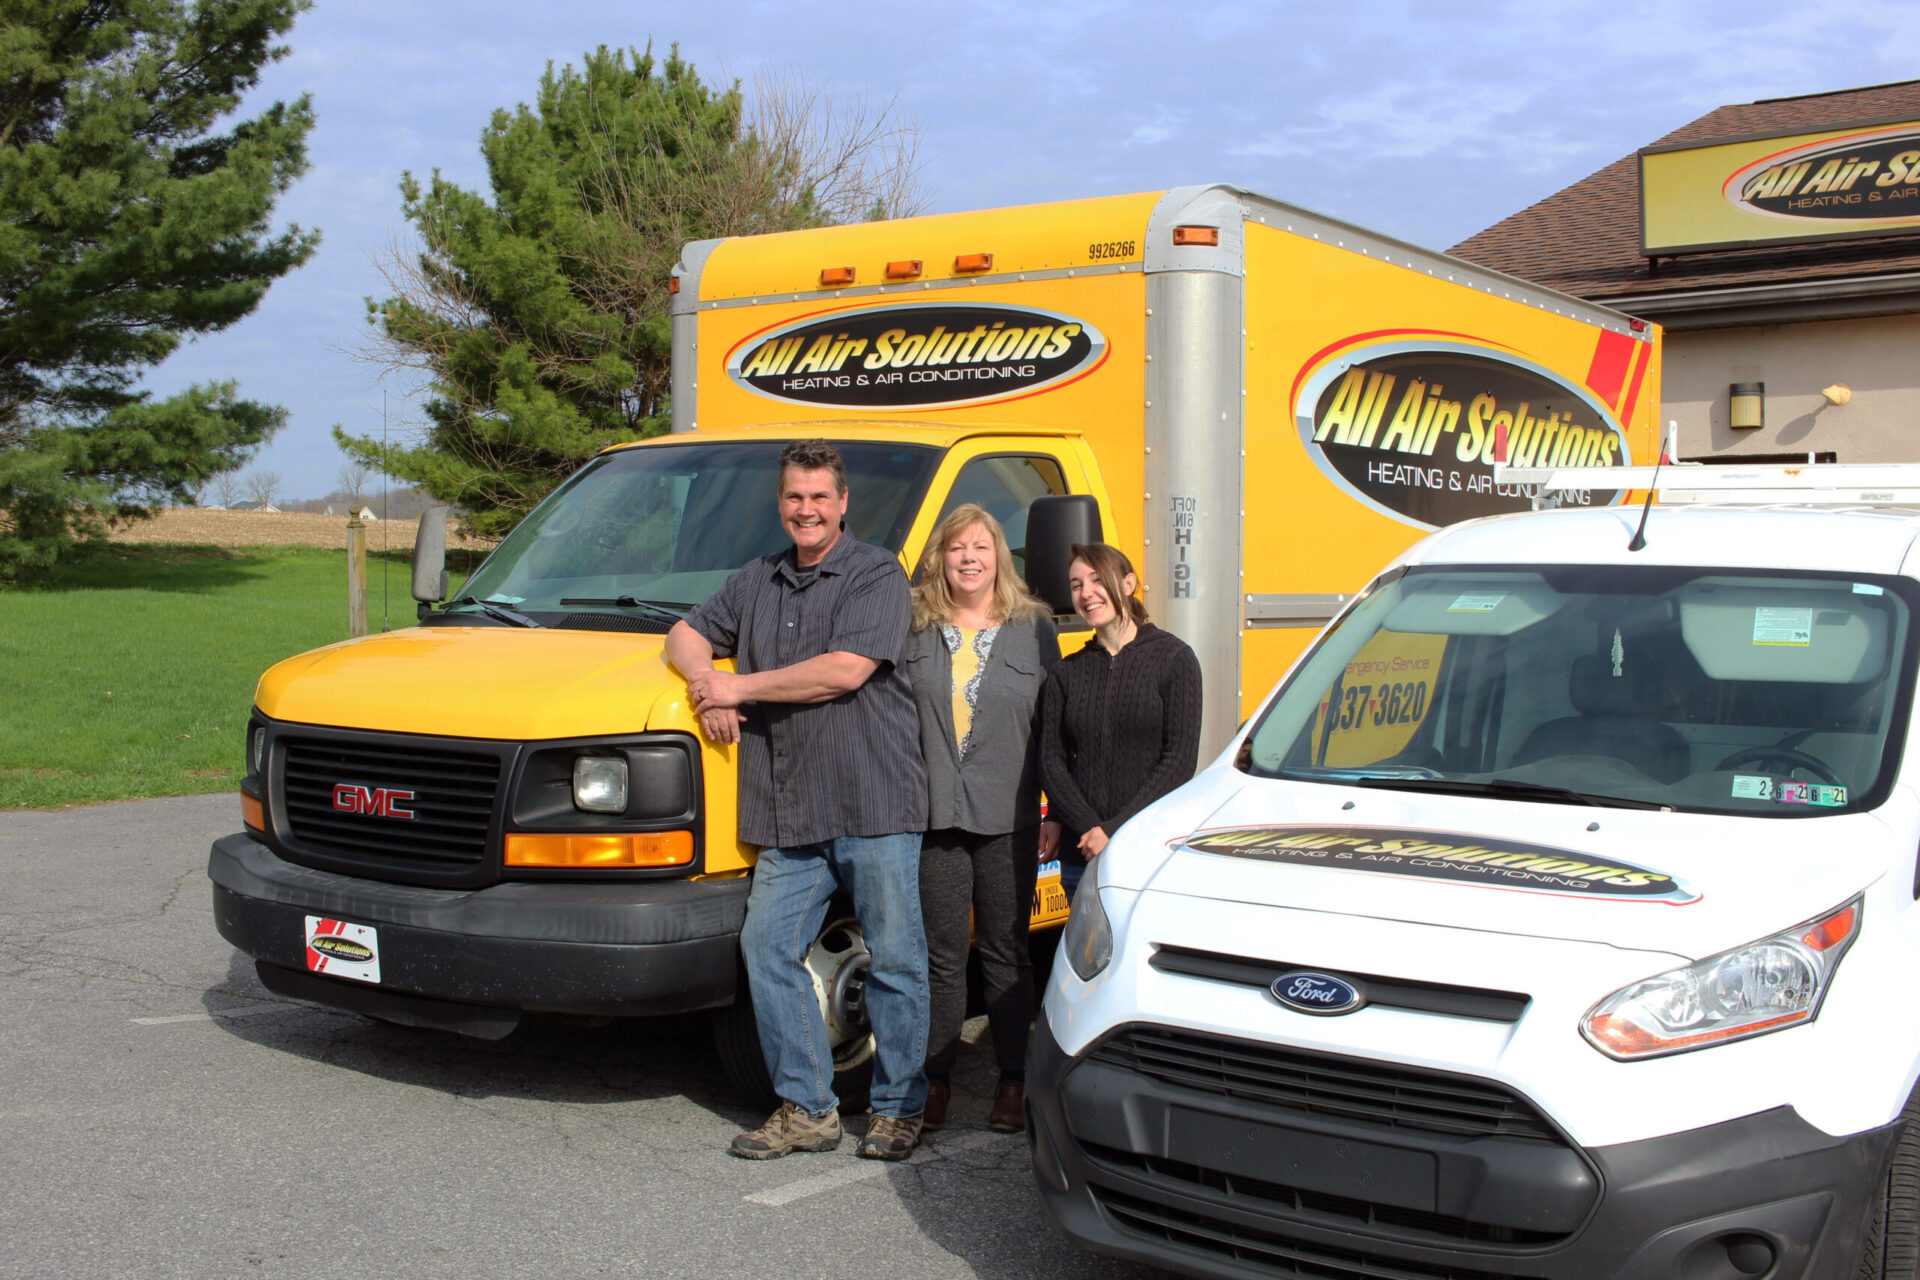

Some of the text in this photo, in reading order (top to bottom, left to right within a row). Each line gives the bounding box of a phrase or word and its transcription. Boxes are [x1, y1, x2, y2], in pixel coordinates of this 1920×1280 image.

[1742, 162, 1813, 201] All
[1798, 156, 1880, 195] Air
[1788, 187, 1919, 209] HEATING & AIR
[1088, 240, 1136, 259] 9926266
[741, 322, 1082, 378] All Air Solutions
[783, 365, 1036, 391] HEATING & AIR CONDITIONING
[1313, 365, 1397, 448] All
[1379, 382, 1461, 456] Air
[1368, 461, 1443, 490] HEATING
[1449, 471, 1463, 491] &
[1466, 473, 1493, 495] AIR
[1345, 656, 1430, 677] ergency Service
[1374, 681, 1427, 727] 3620
[333, 783, 415, 819] GMC
[1759, 780, 1767, 796] 2
[1811, 788, 1846, 803] 6 21
[1187, 832, 1671, 886] All Air Solutions
[1232, 848, 1327, 858] HEATING
[1360, 854, 1402, 864] AIR
[1409, 858, 1590, 889] CONDITIONING
[335, 942, 372, 957] Solutions
[1287, 977, 1338, 1003] Ford
